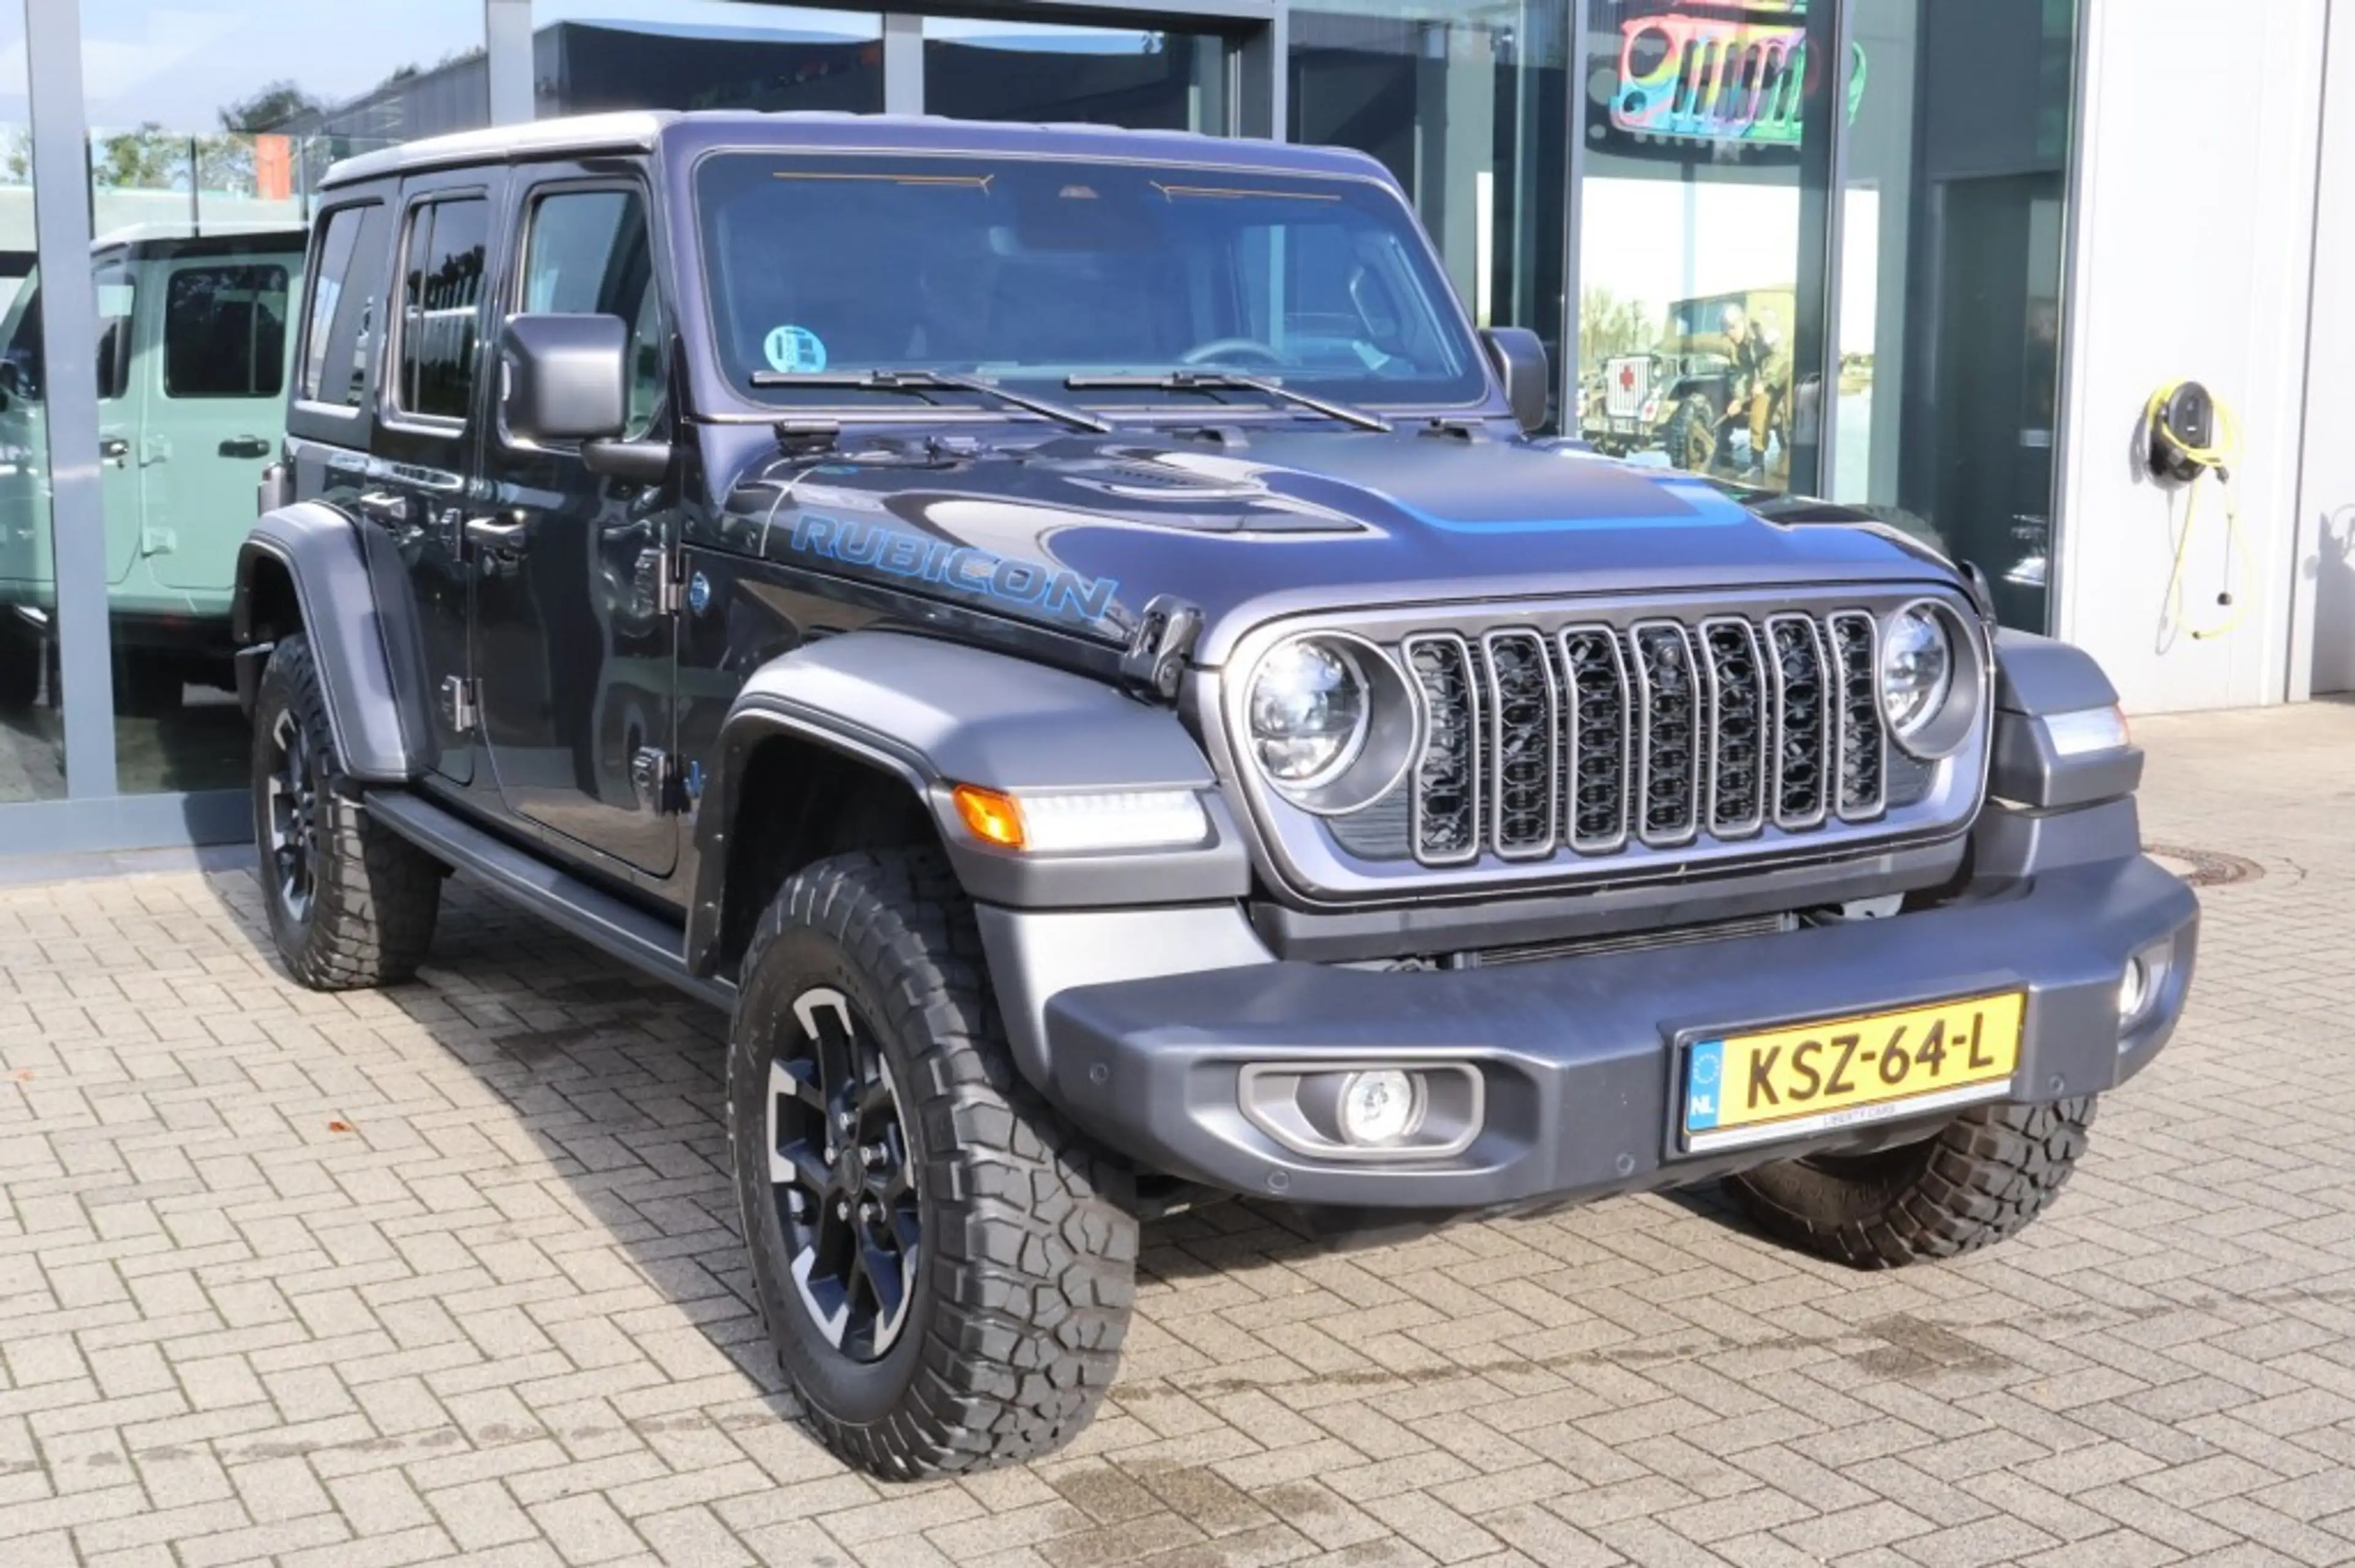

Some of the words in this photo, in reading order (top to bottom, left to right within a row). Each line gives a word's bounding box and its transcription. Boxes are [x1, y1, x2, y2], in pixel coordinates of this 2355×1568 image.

[792, 514, 1118, 620] RUBICON
[1690, 1094, 1715, 1116] NL
[1747, 1013, 1994, 1107] KSZ-64-L
